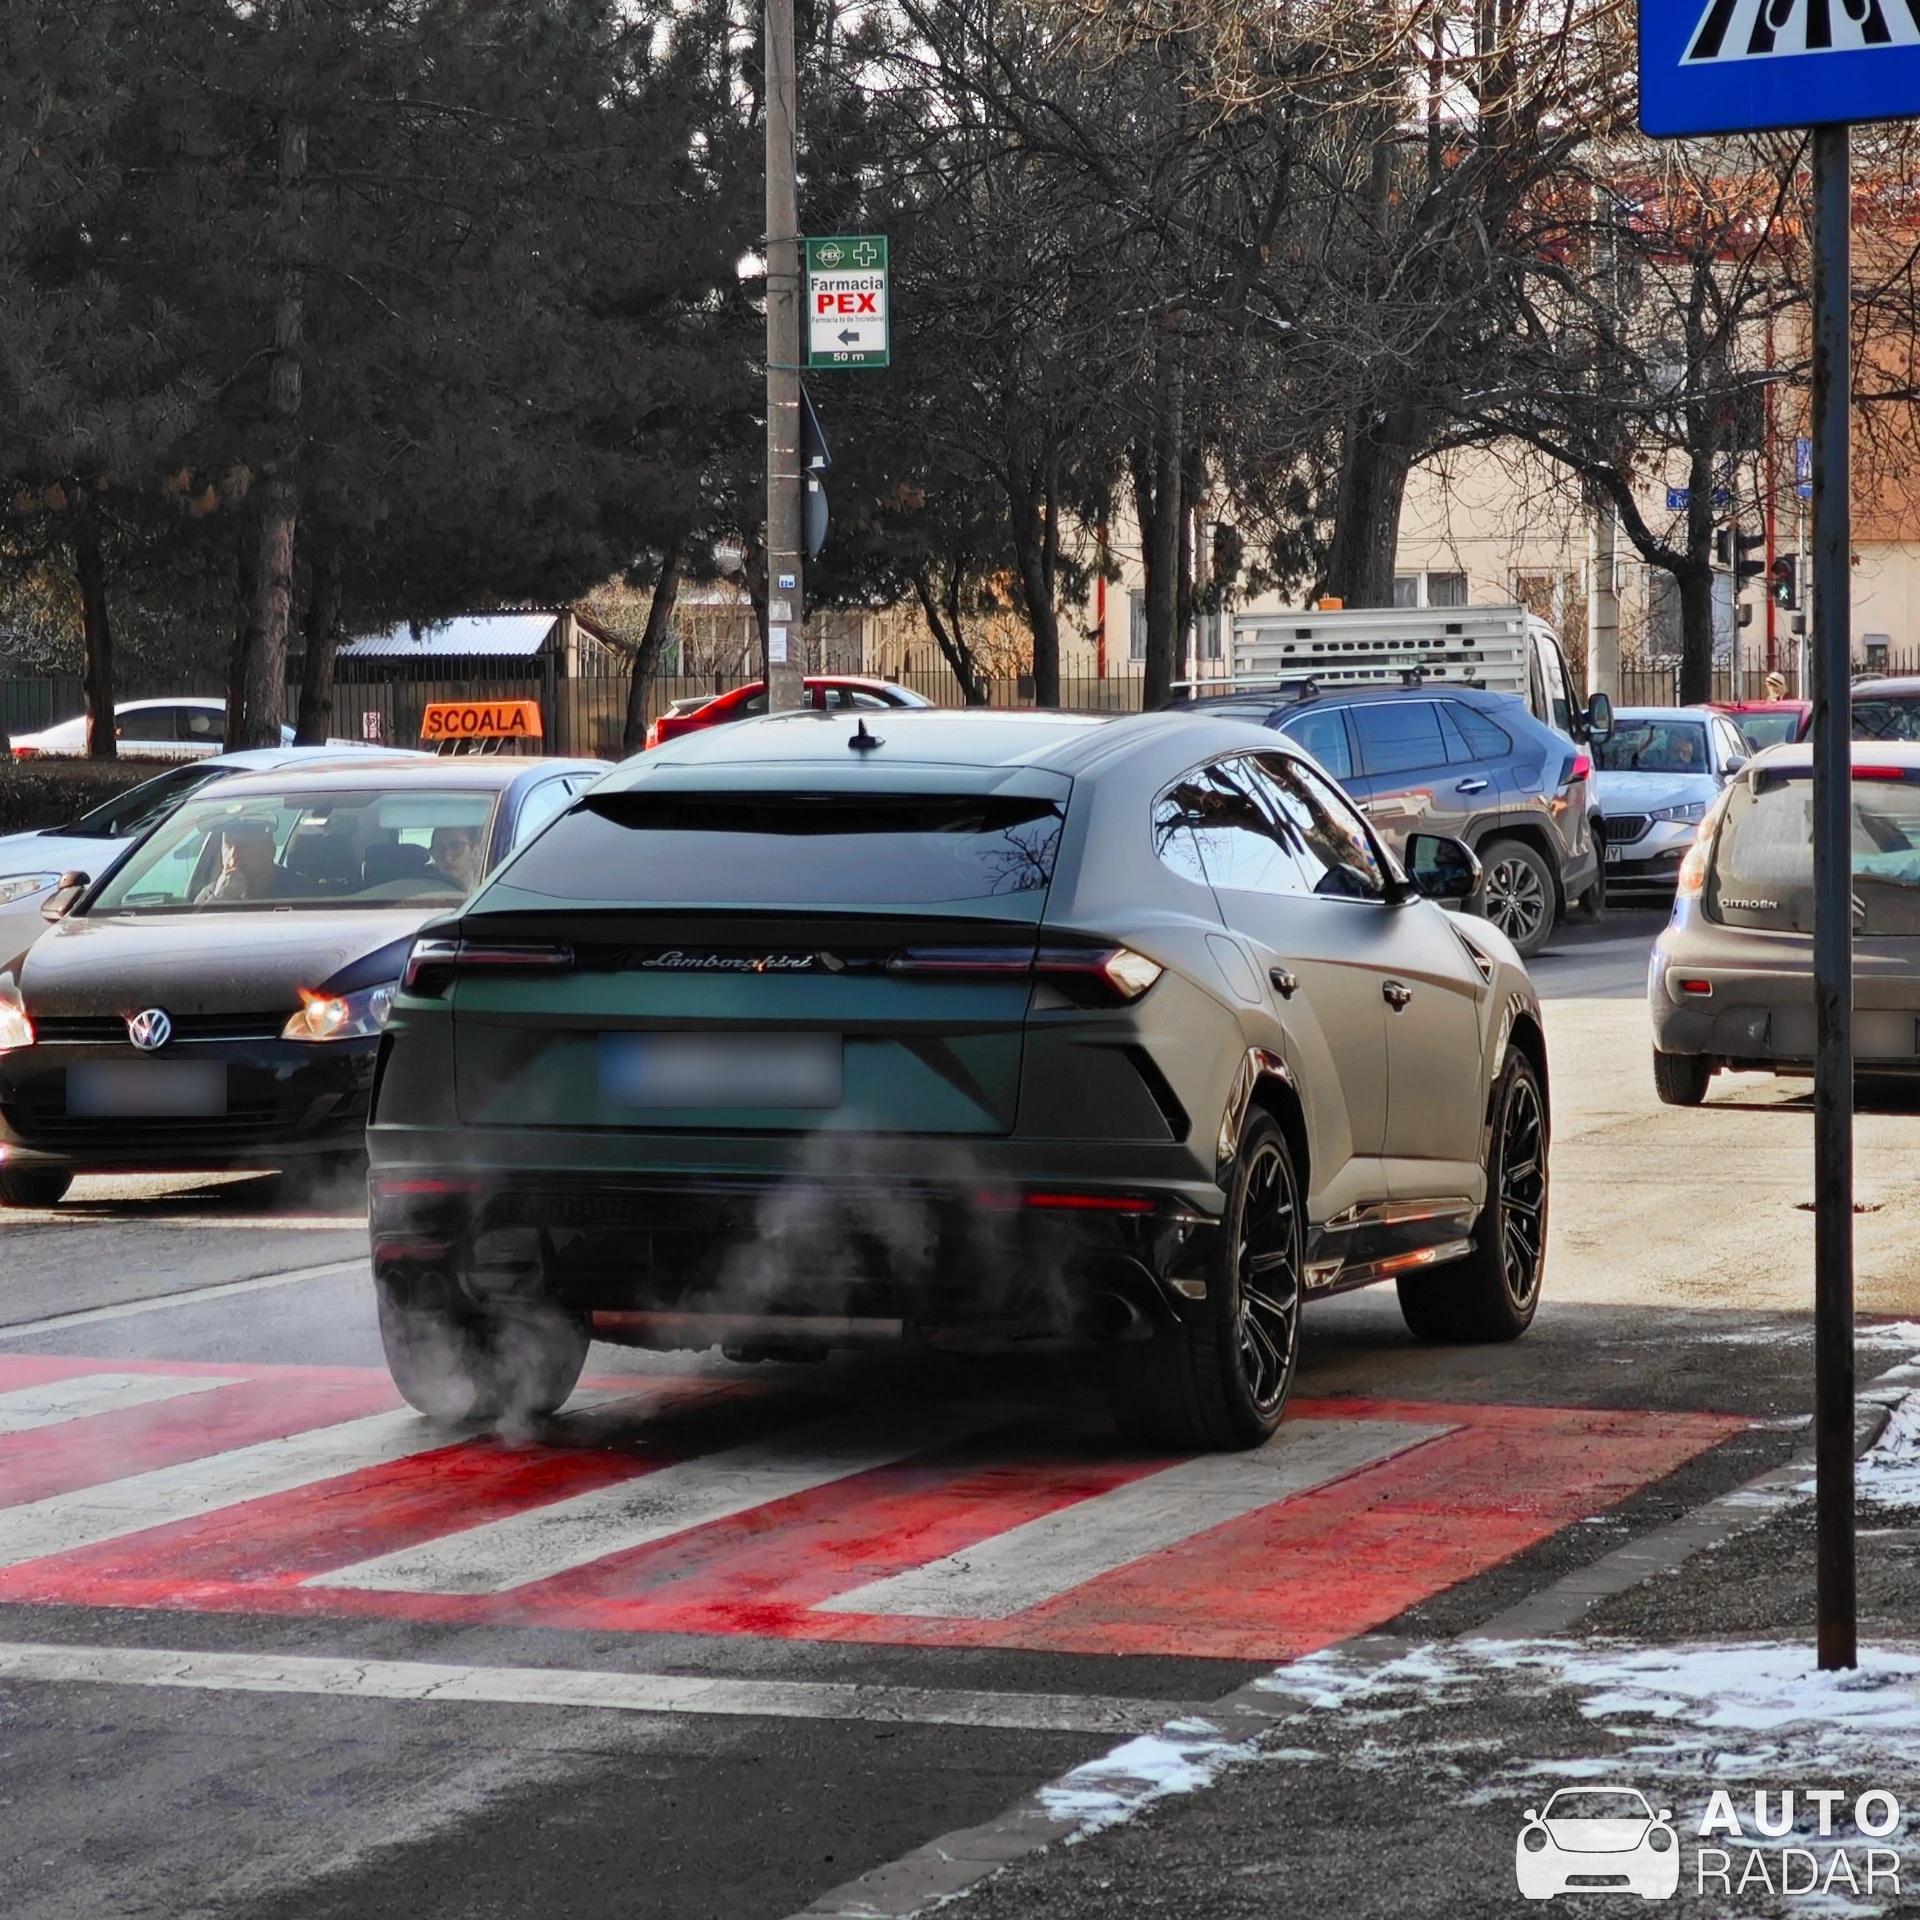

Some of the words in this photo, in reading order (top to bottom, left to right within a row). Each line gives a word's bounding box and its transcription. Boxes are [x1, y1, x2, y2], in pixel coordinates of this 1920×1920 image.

[811, 276, 884, 291] Farmacia
[817, 293, 877, 314] PEX
[833, 352, 849, 362] 50
[852, 353, 865, 361] m
[428, 708, 526, 733] SCOALA
[1720, 898, 1778, 909] CITROËN
[642, 950, 813, 972] Lamborghini
